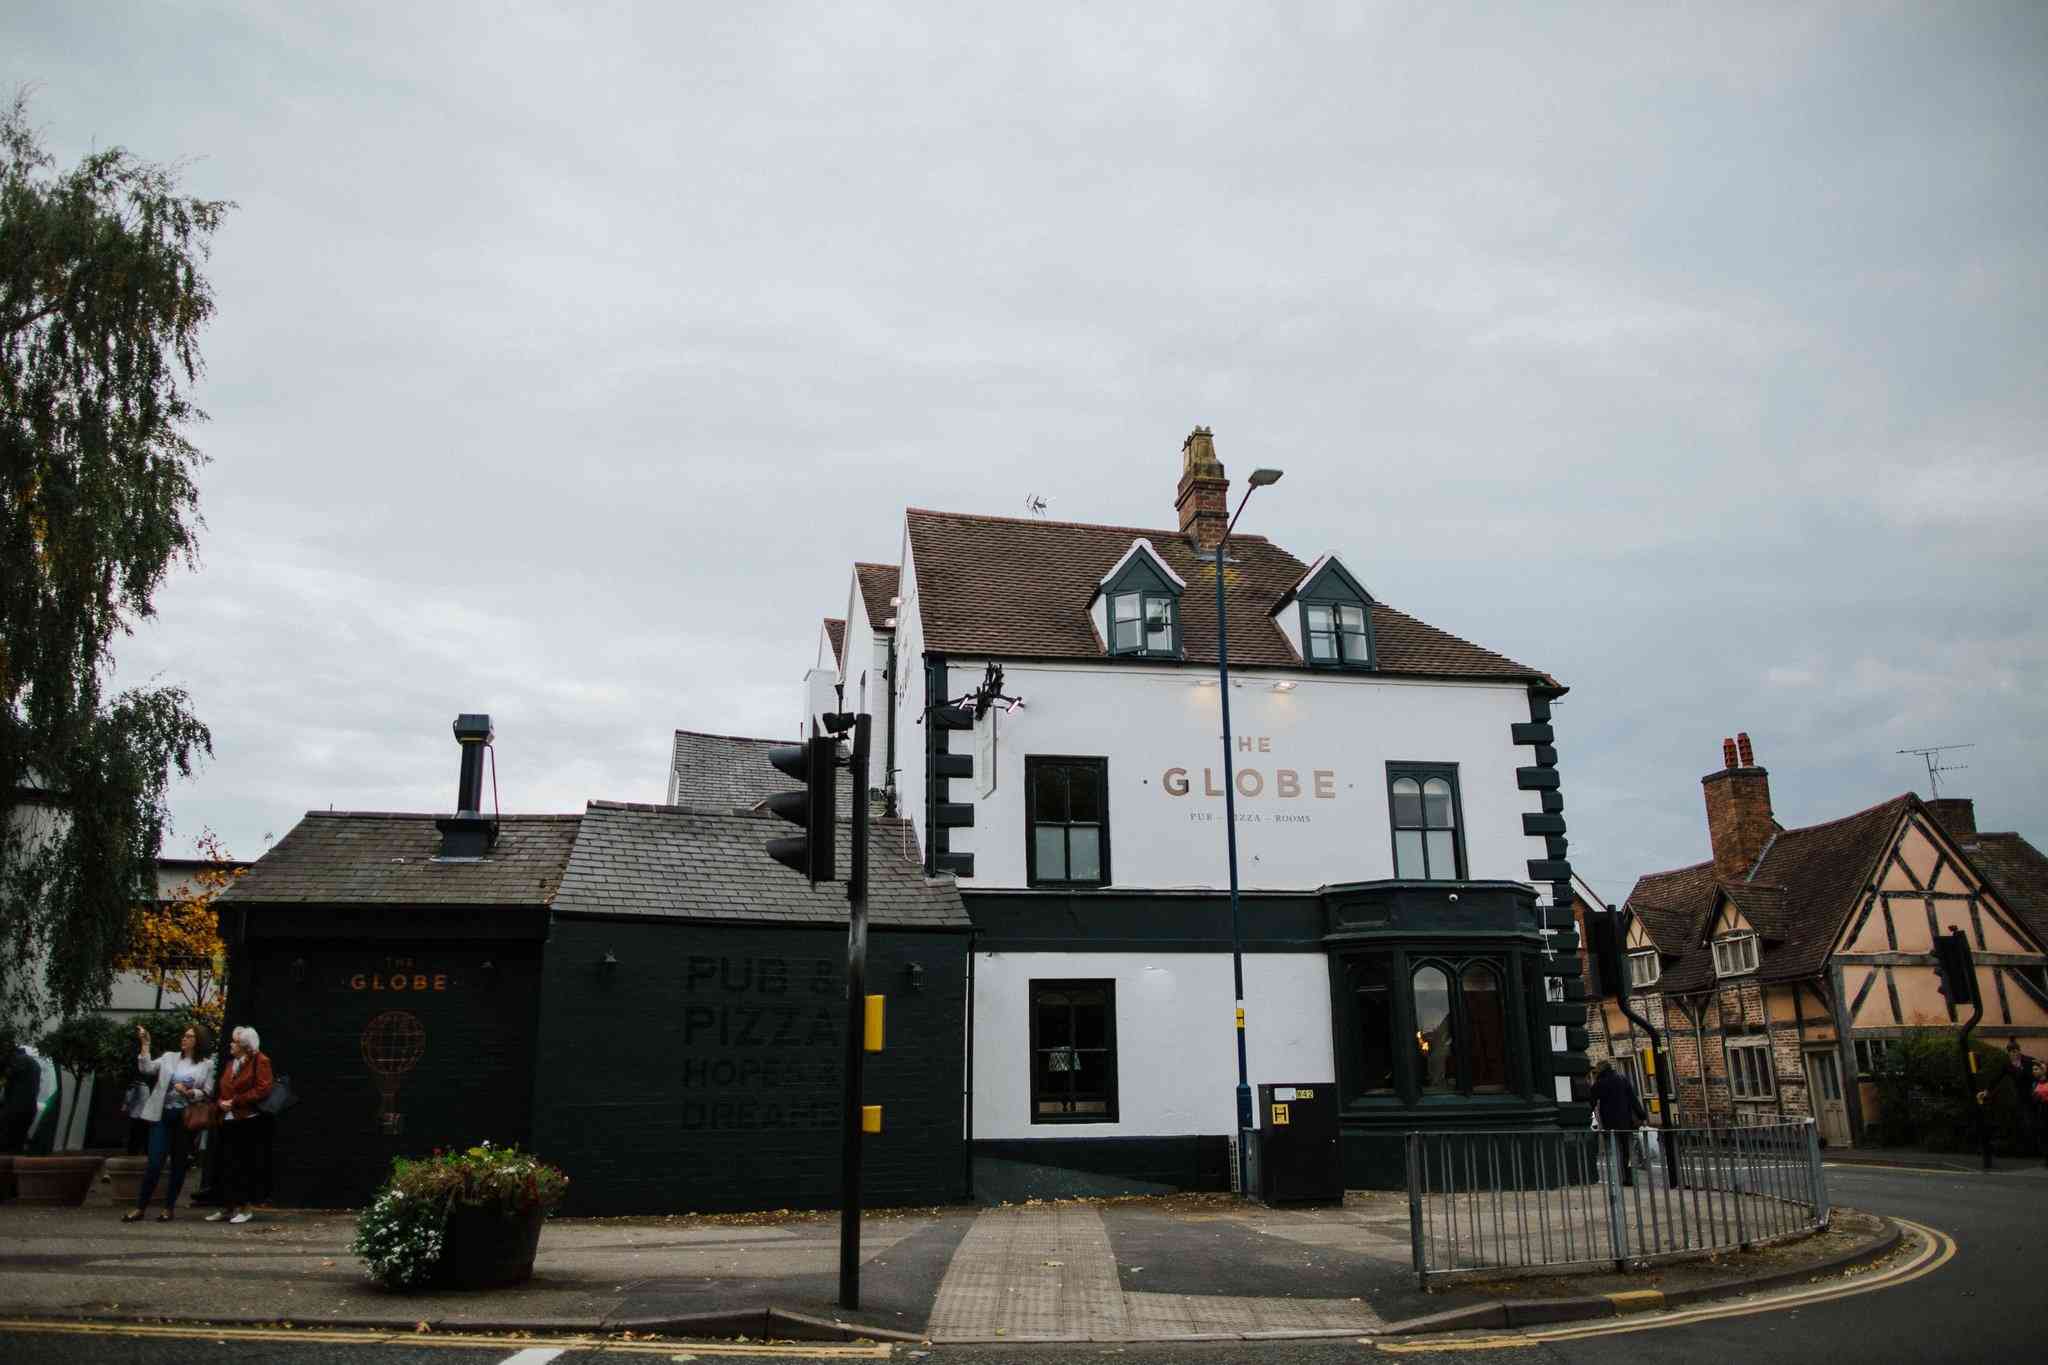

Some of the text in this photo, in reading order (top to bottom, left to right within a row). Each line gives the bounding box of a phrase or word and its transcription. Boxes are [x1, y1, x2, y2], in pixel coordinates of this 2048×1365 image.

[1163, 767, 1336, 799] GLOBE
[1275, 814, 1311, 823] ROOMS
[351, 974, 448, 991] GLOBE
[687, 956, 788, 992] PUB
[685, 1007, 840, 1045] PIZZA
